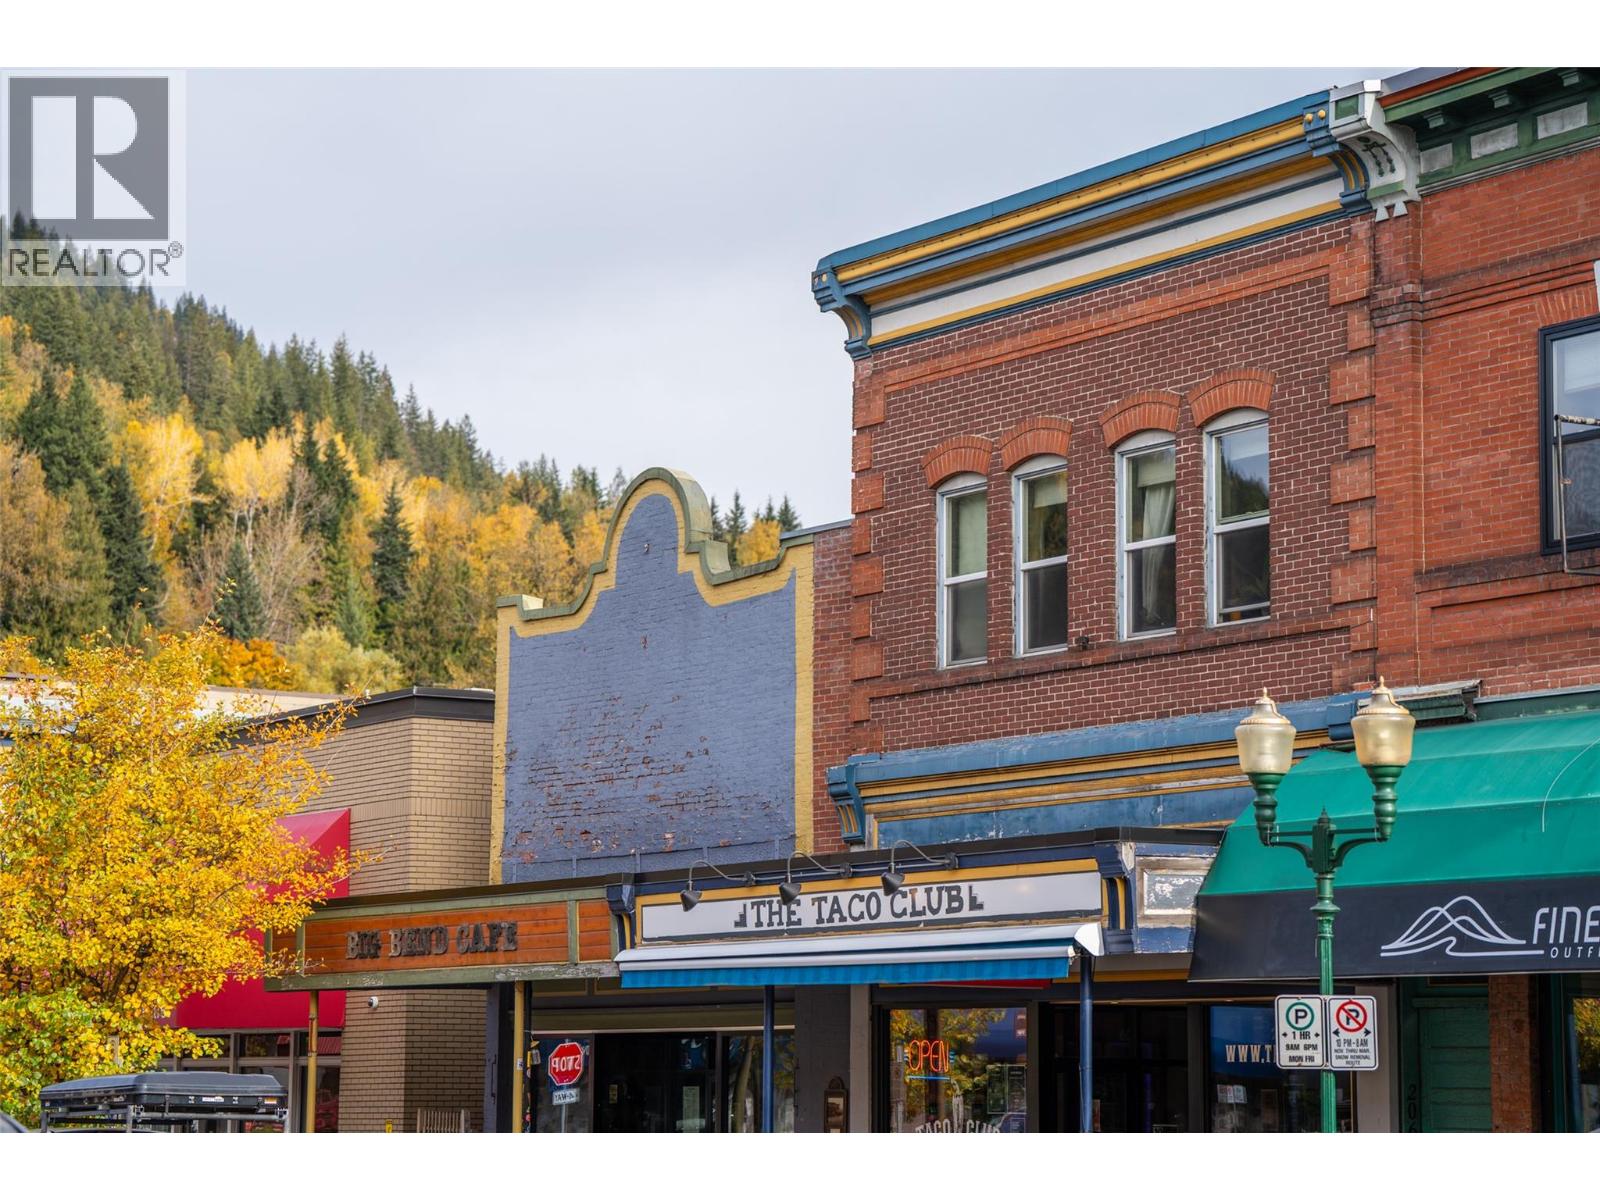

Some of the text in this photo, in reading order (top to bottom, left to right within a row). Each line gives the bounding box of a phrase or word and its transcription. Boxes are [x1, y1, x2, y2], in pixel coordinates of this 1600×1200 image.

[751, 885, 964, 928] THE TACO CLUB
[345, 921, 518, 960] BIG BEND CAFE
[1291, 1031, 1311, 1040] 1 HR
[908, 1040, 950, 1072] OPEN
[1285, 1043, 1300, 1051] 9AM
[1288, 1055, 1315, 1063] MON FRI
